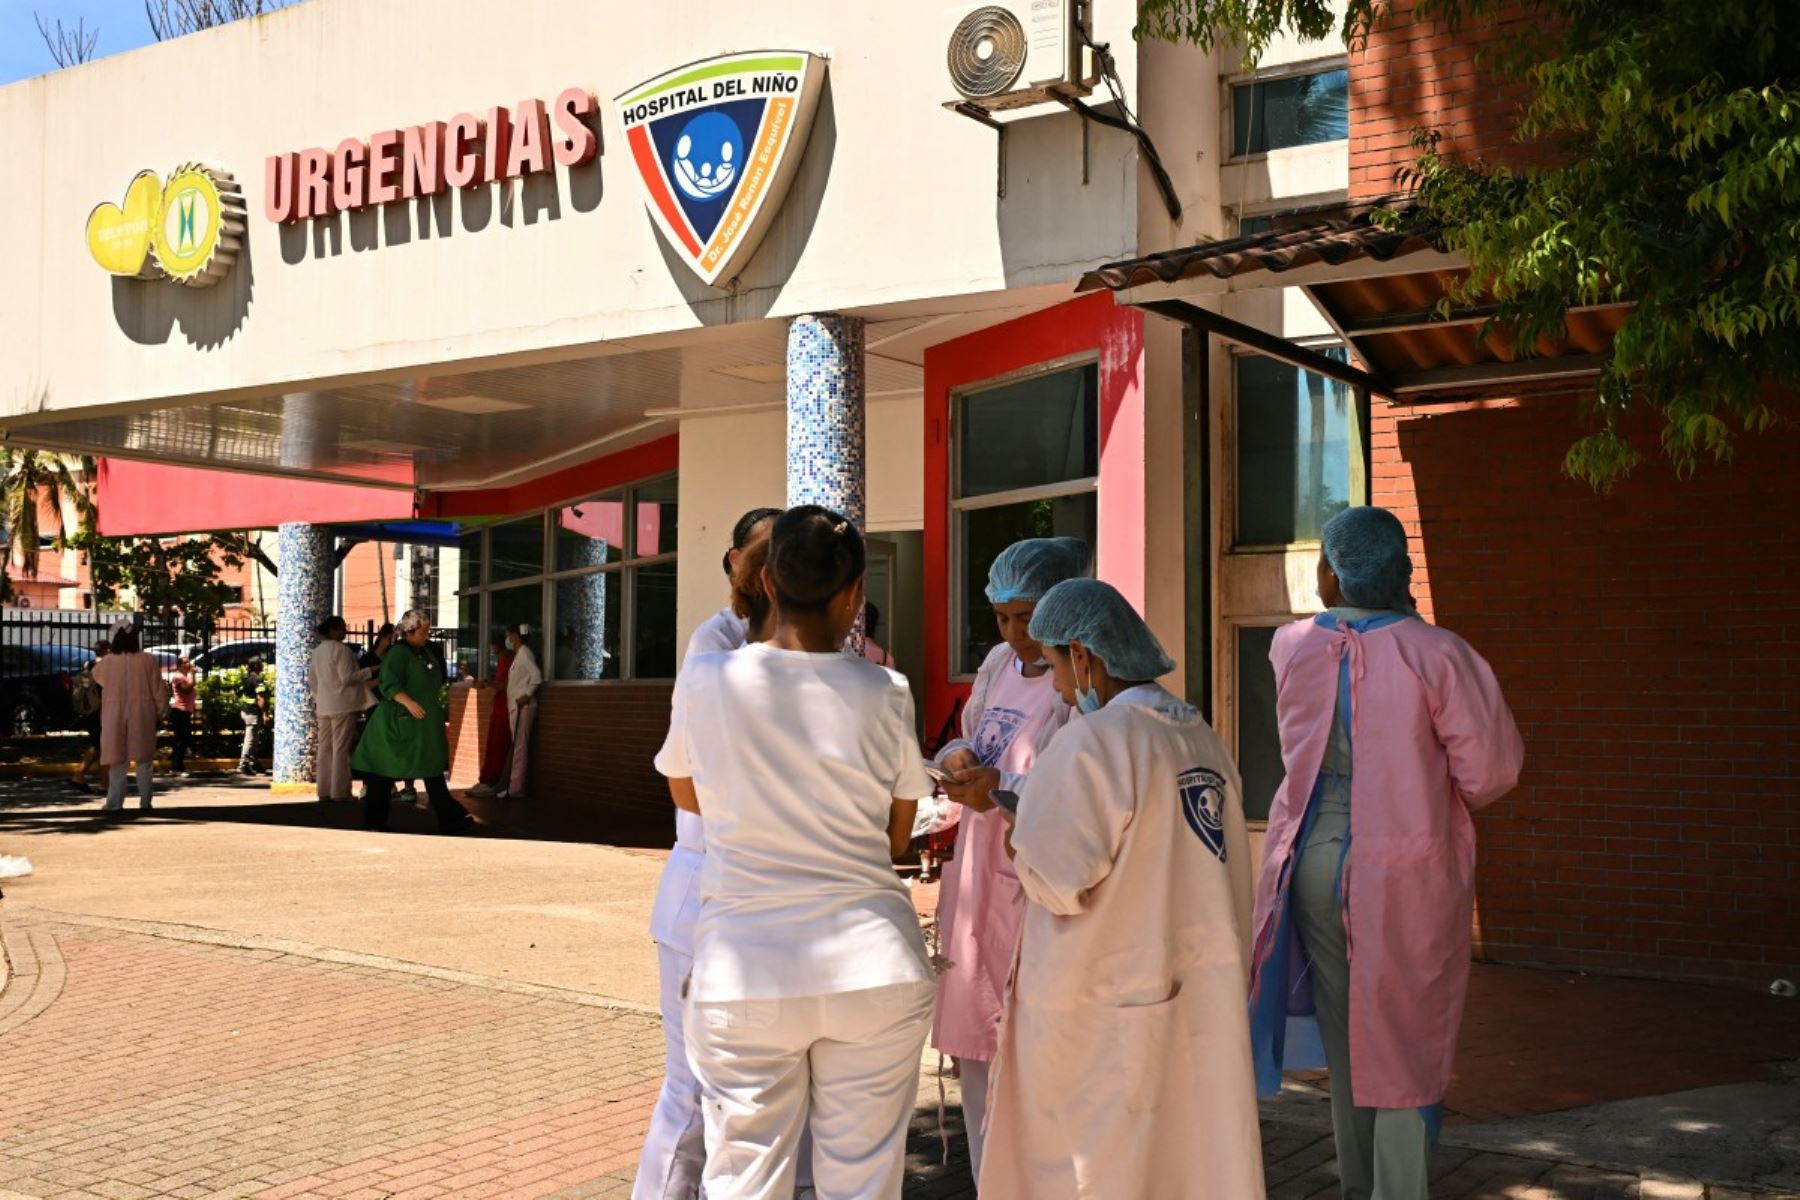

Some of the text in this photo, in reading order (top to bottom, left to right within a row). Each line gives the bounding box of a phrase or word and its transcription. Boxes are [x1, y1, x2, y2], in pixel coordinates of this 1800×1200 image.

[264, 87, 597, 224] URGENCIAS
[623, 72, 799, 126] HOSPITAL DEL NIÑO
[708, 245, 723, 263] Dr.
[761, 102, 788, 165] Esquivel
